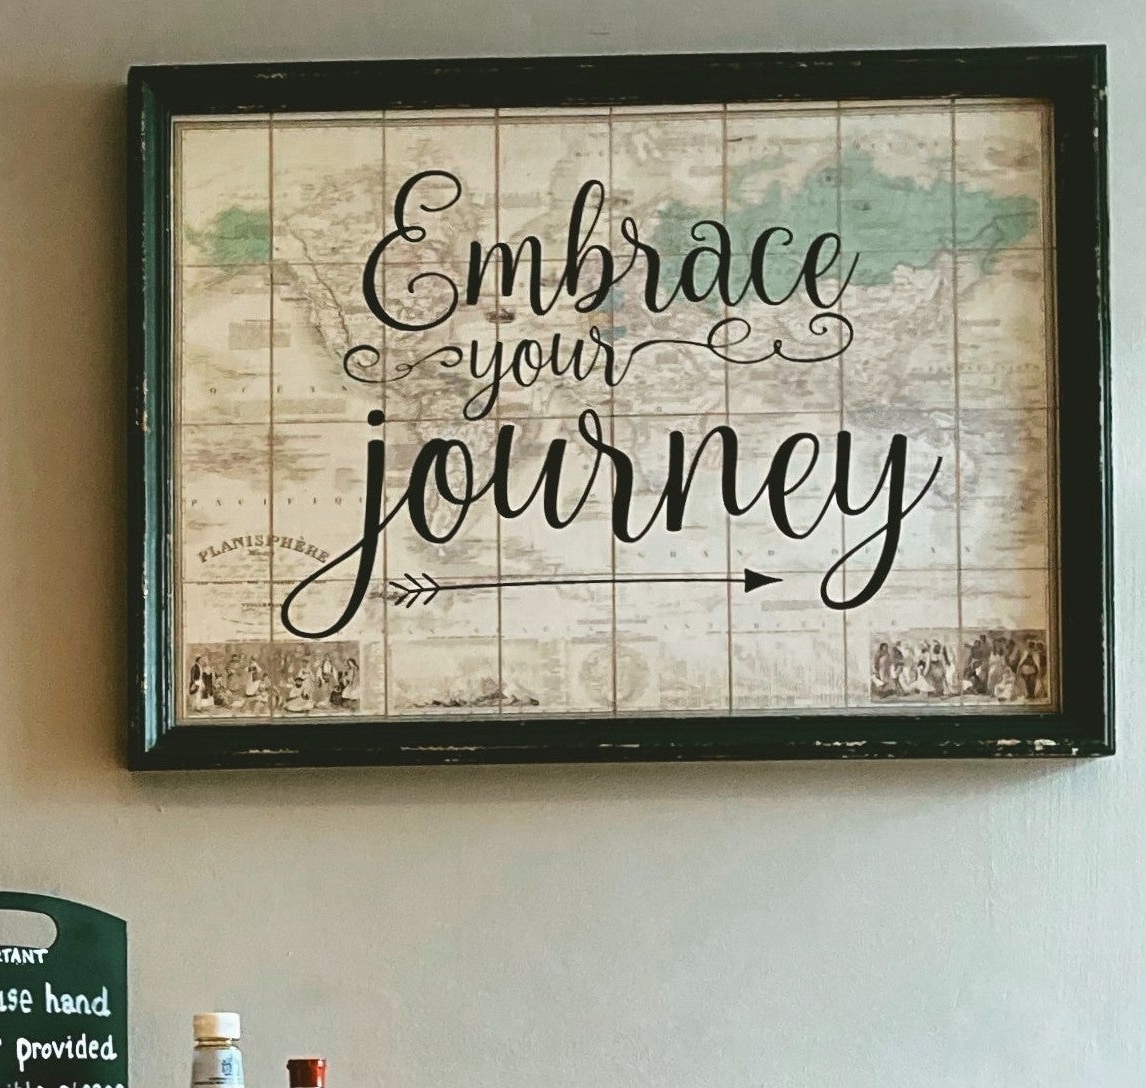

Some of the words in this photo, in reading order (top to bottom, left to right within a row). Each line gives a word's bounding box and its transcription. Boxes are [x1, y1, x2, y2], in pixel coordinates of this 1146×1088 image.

[362, 170, 860, 331] Embrace
[281, 409, 942, 640] journey
[45, 982, 111, 1017] hand
[16, 1033, 118, 1072] provided
